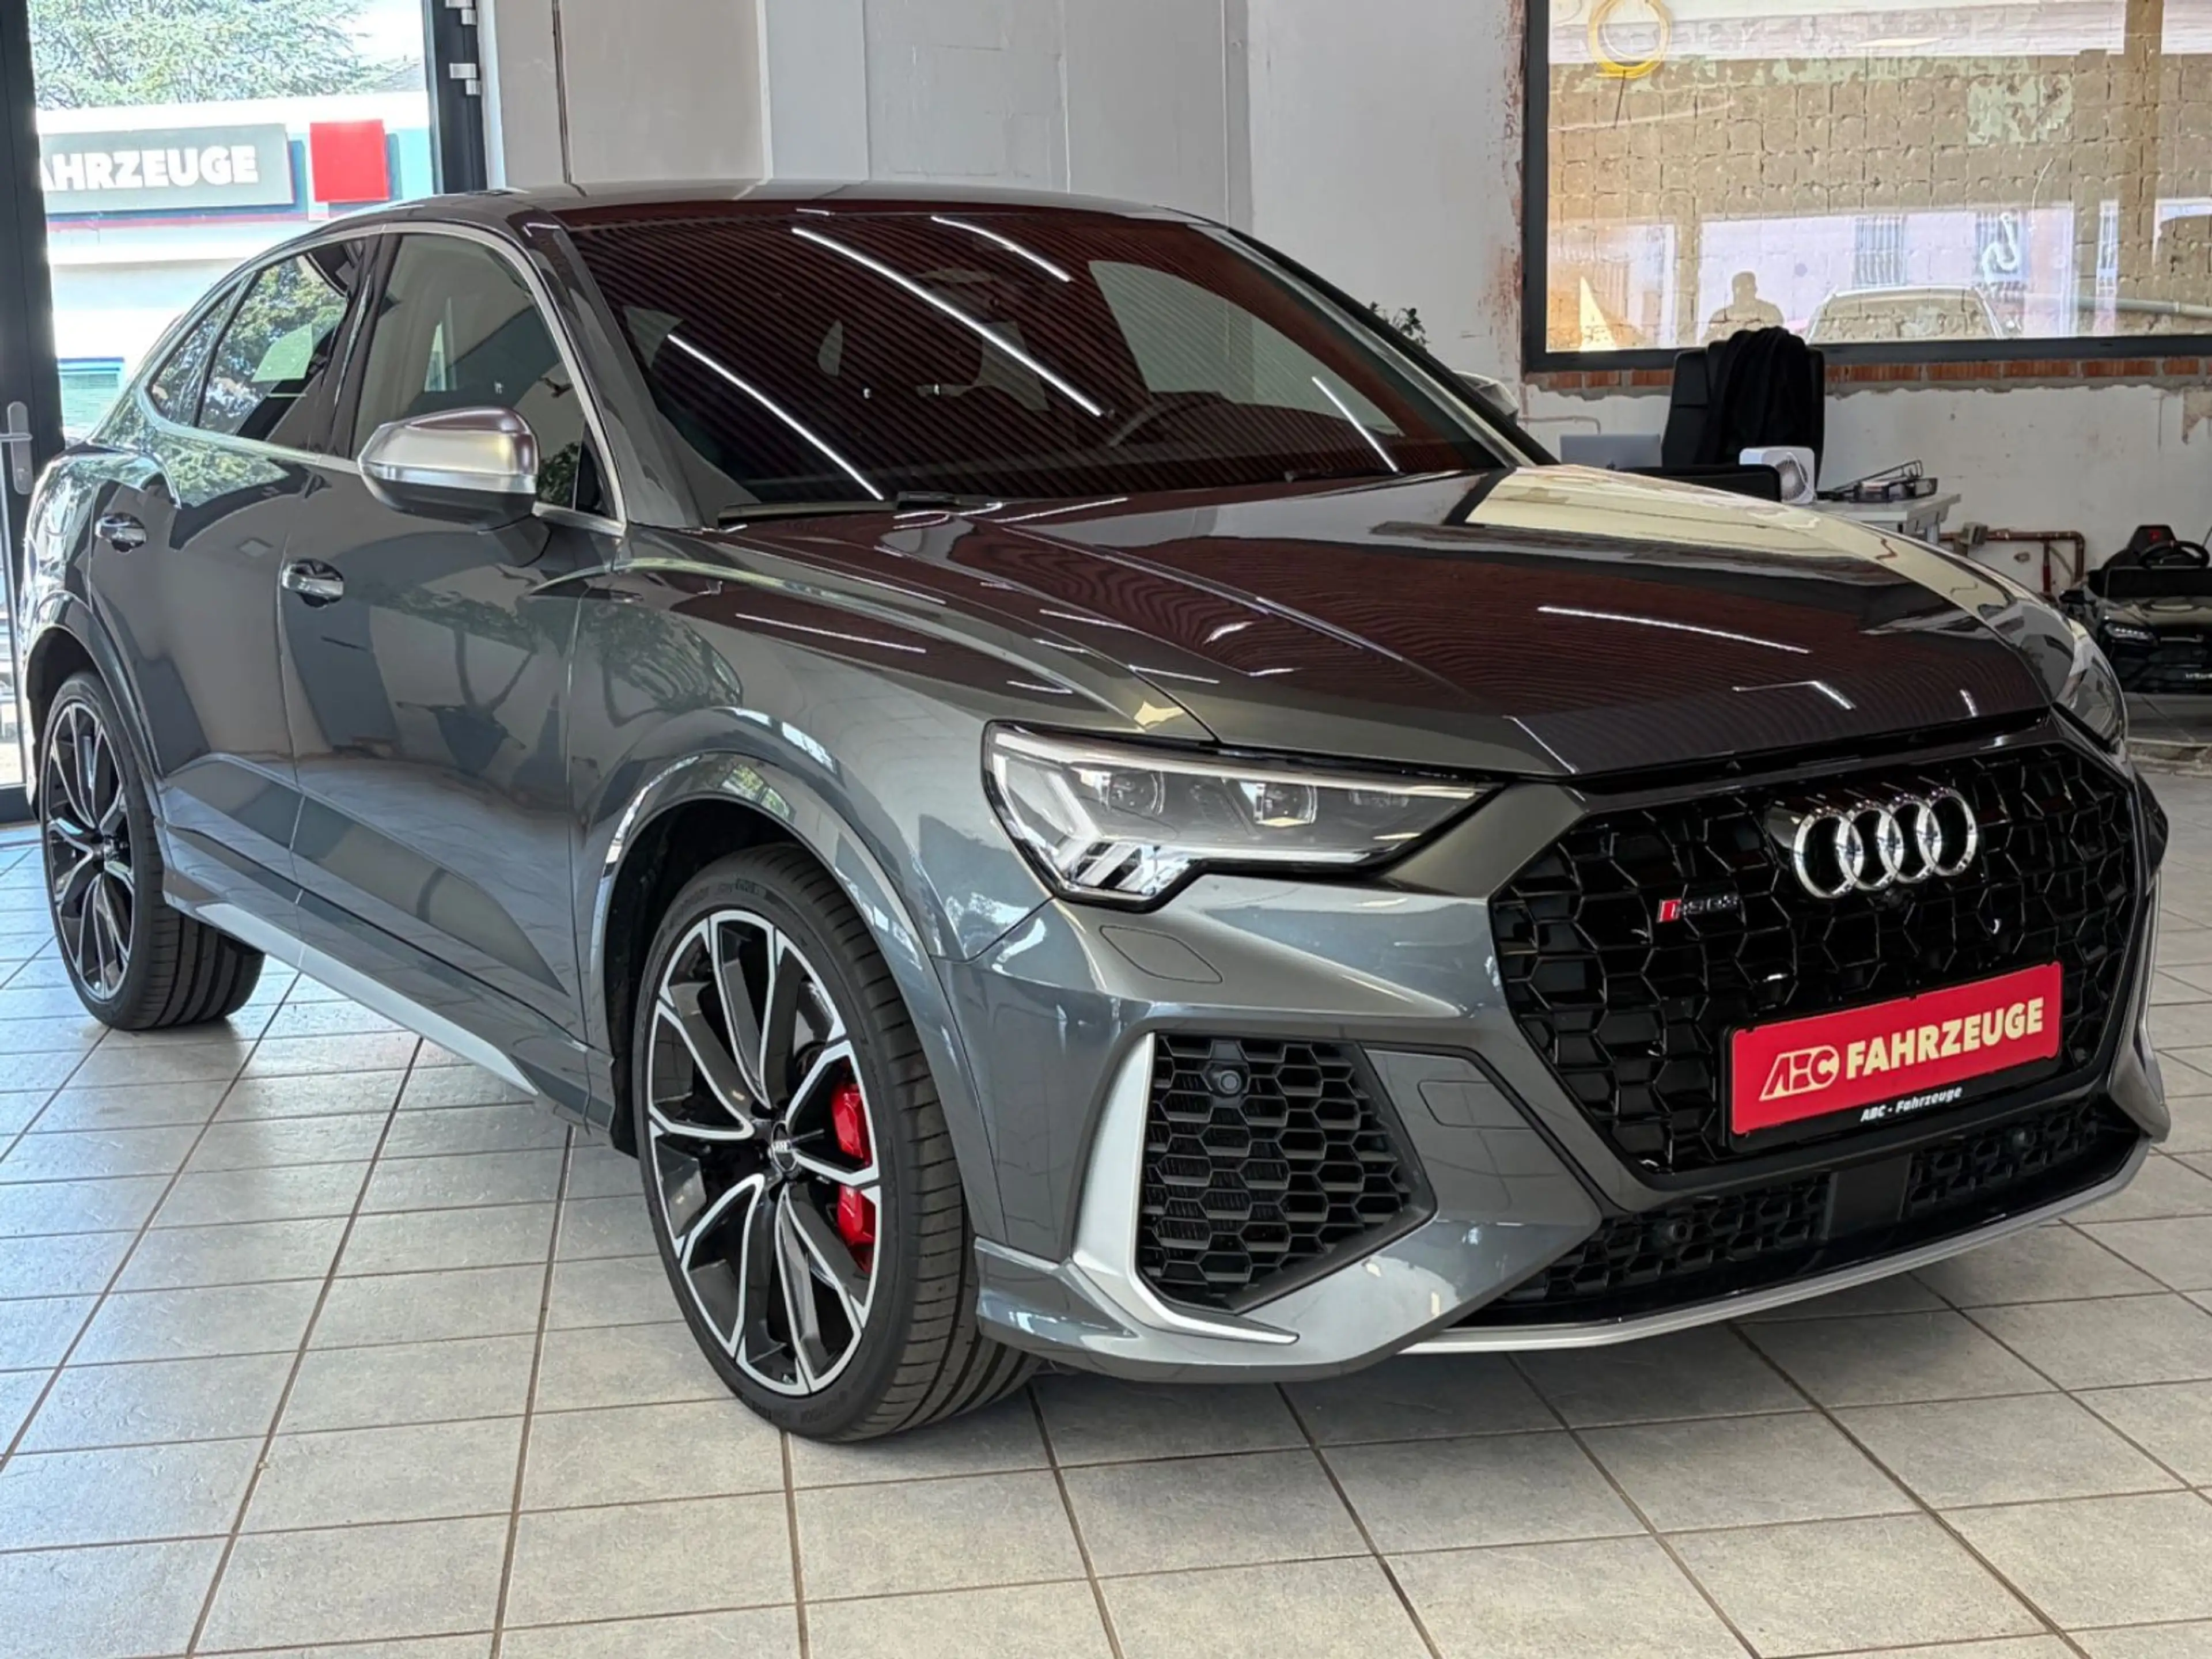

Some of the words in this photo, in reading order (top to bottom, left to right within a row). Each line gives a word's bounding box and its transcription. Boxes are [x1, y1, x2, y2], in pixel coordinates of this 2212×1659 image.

[1847, 997, 2044, 1079] FAHRZEUGE
[1859, 1104, 1887, 1122] ABC
[1895, 1086, 1963, 1113] Fahrzeuge
